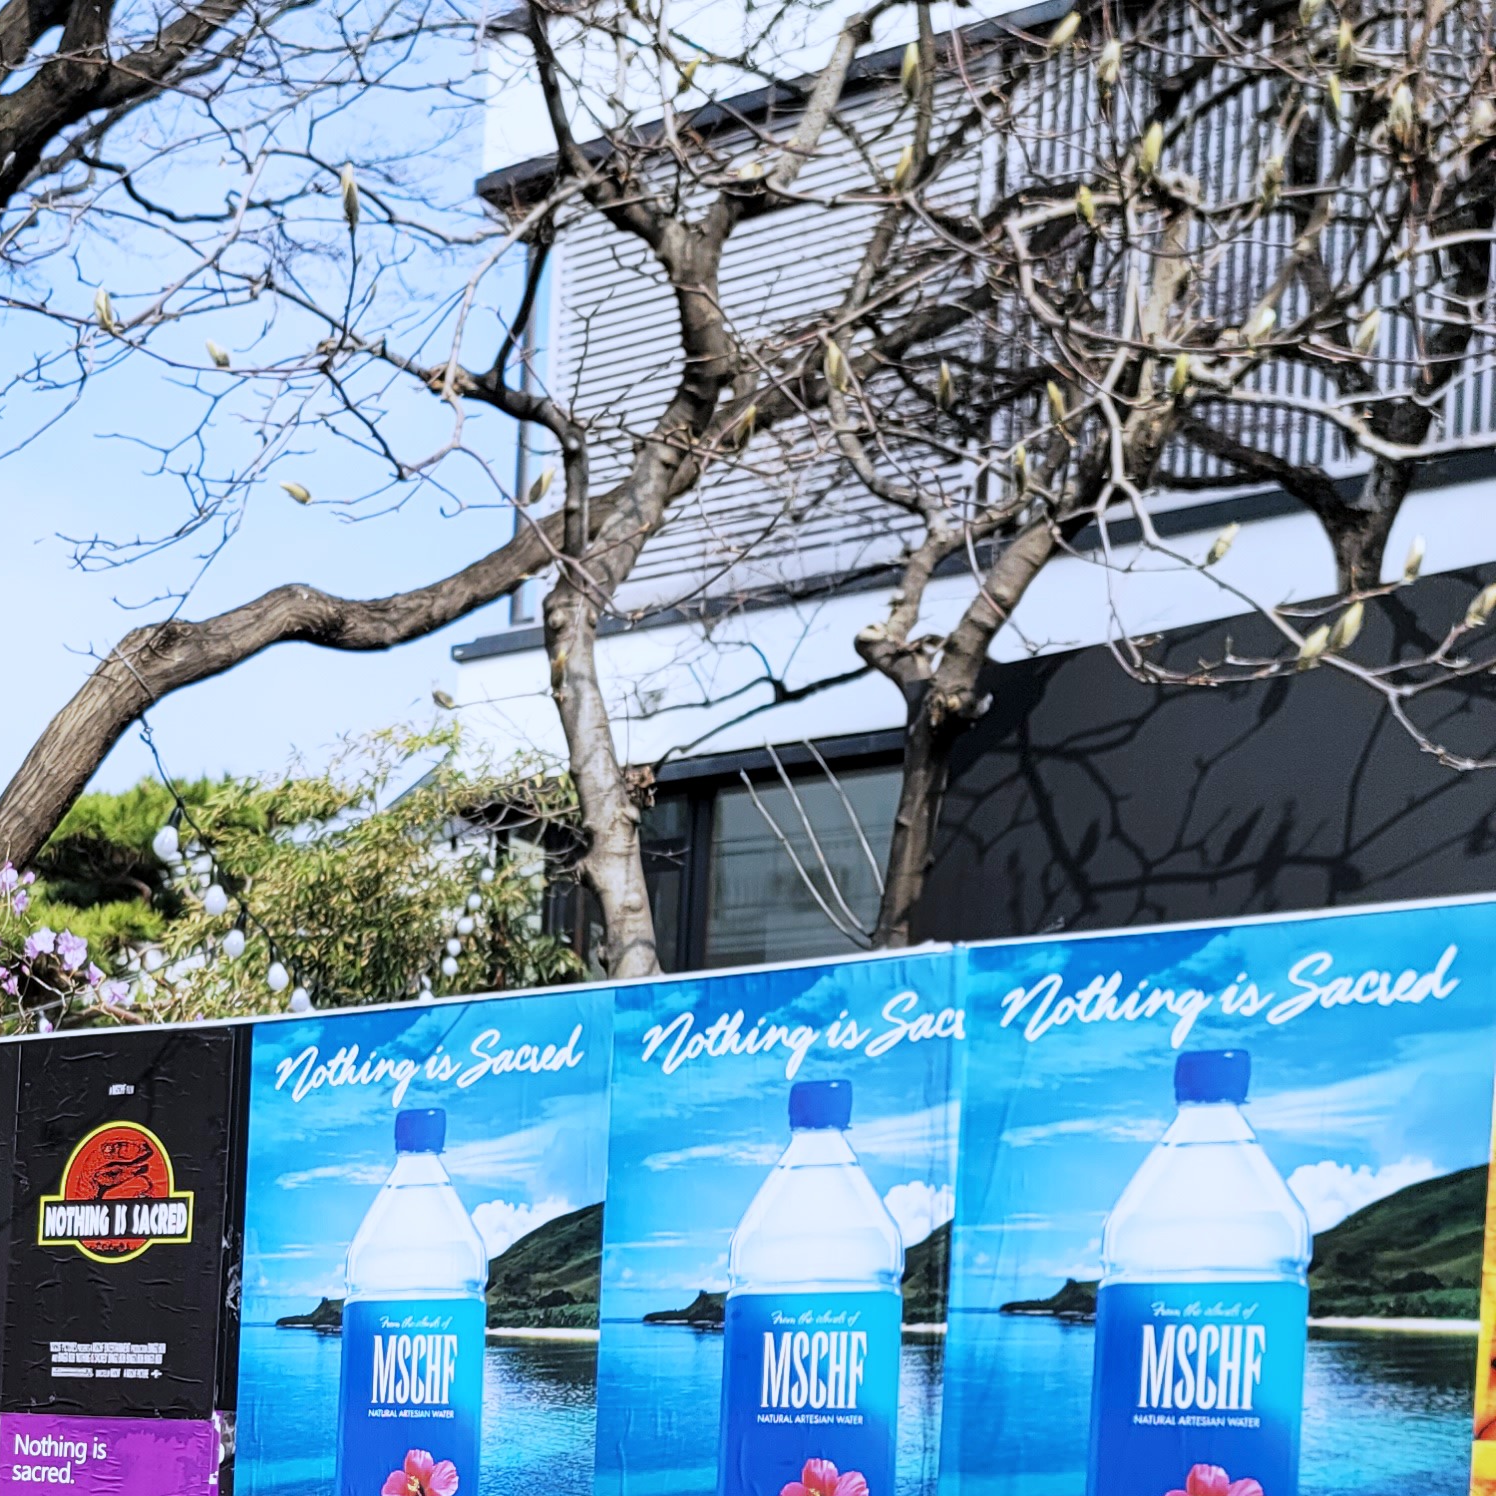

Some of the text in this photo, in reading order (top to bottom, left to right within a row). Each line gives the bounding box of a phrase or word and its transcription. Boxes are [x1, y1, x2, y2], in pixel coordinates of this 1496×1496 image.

[999, 945, 1459, 1049] Nothing is Sacred
[641, 991, 965, 1080] Nothing is Sacr
[275, 1023, 584, 1108] Nothing is Sacred
[45, 1202, 187, 1237] NOTHING IS SACRED
[371, 1335, 457, 1404] MSCHF
[760, 1331, 867, 1409] MSCHF
[1137, 1324, 1266, 1410] MSCHF
[368, 1408, 454, 1419] NATURAL ARTESIAN WATER
[758, 1414, 863, 1425] NATURAL ARTESIAN WATER
[1133, 1415, 1260, 1428] NATURAL ARTESIAN WATER
[12, 1462, 75, 1484] sacred.
[14, 1434, 107, 1464] Nothing is
